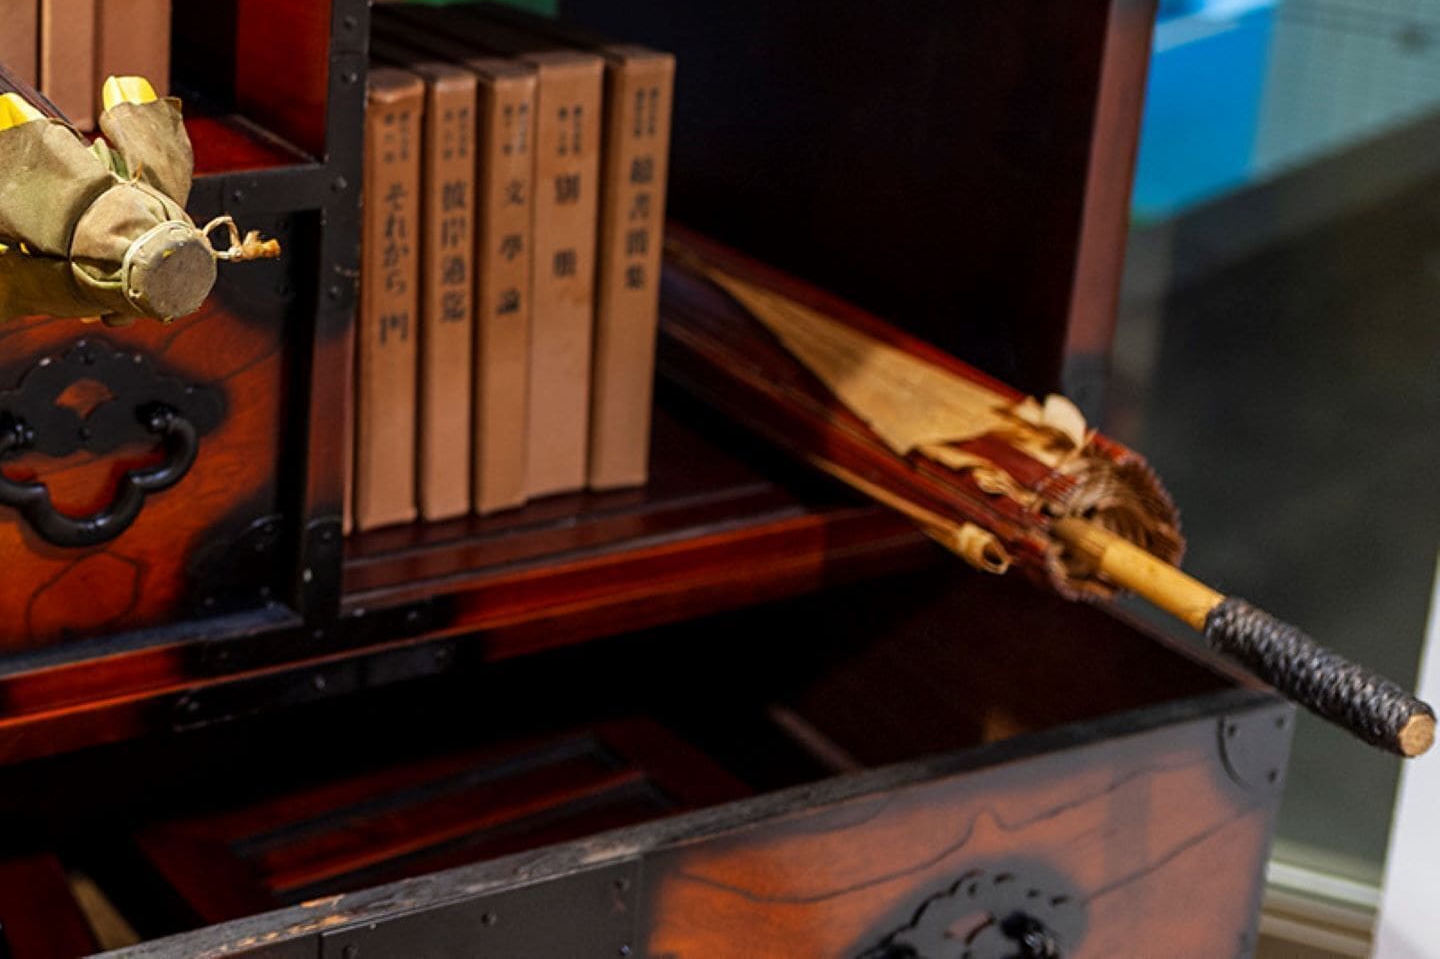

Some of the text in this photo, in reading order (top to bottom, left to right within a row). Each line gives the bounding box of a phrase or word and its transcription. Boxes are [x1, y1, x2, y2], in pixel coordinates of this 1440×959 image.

[383, 183, 409, 294] それから
[379, 312, 409, 346] 門
